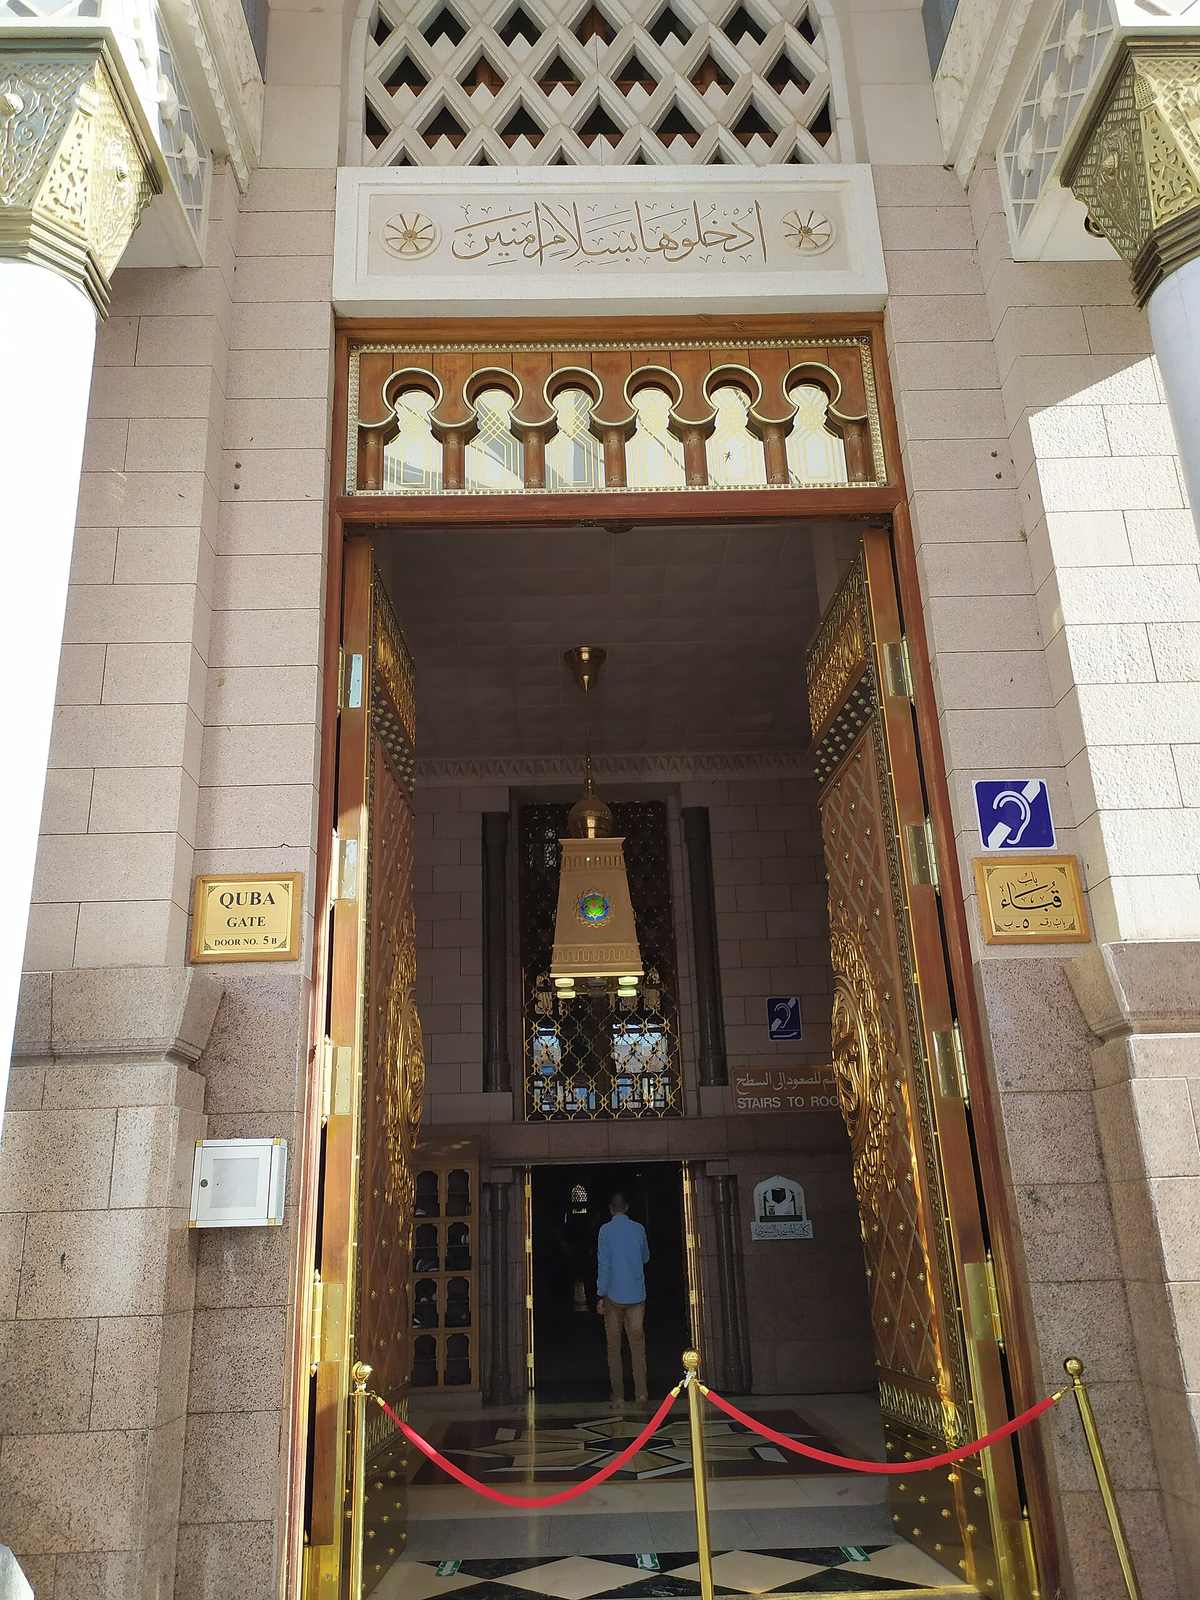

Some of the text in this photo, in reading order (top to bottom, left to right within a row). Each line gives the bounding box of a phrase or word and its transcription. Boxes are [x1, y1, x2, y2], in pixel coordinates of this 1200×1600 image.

[219, 891, 276, 909] QUBA
[226, 916, 266, 928] GATE
[214, 938, 241, 947] DOOR
[243, 937, 259, 946] NO.
[262, 935, 269, 945] 5
[736, 1071, 772, 1095] السطح
[737, 1095, 840, 1110] STAIRS TO ROO
